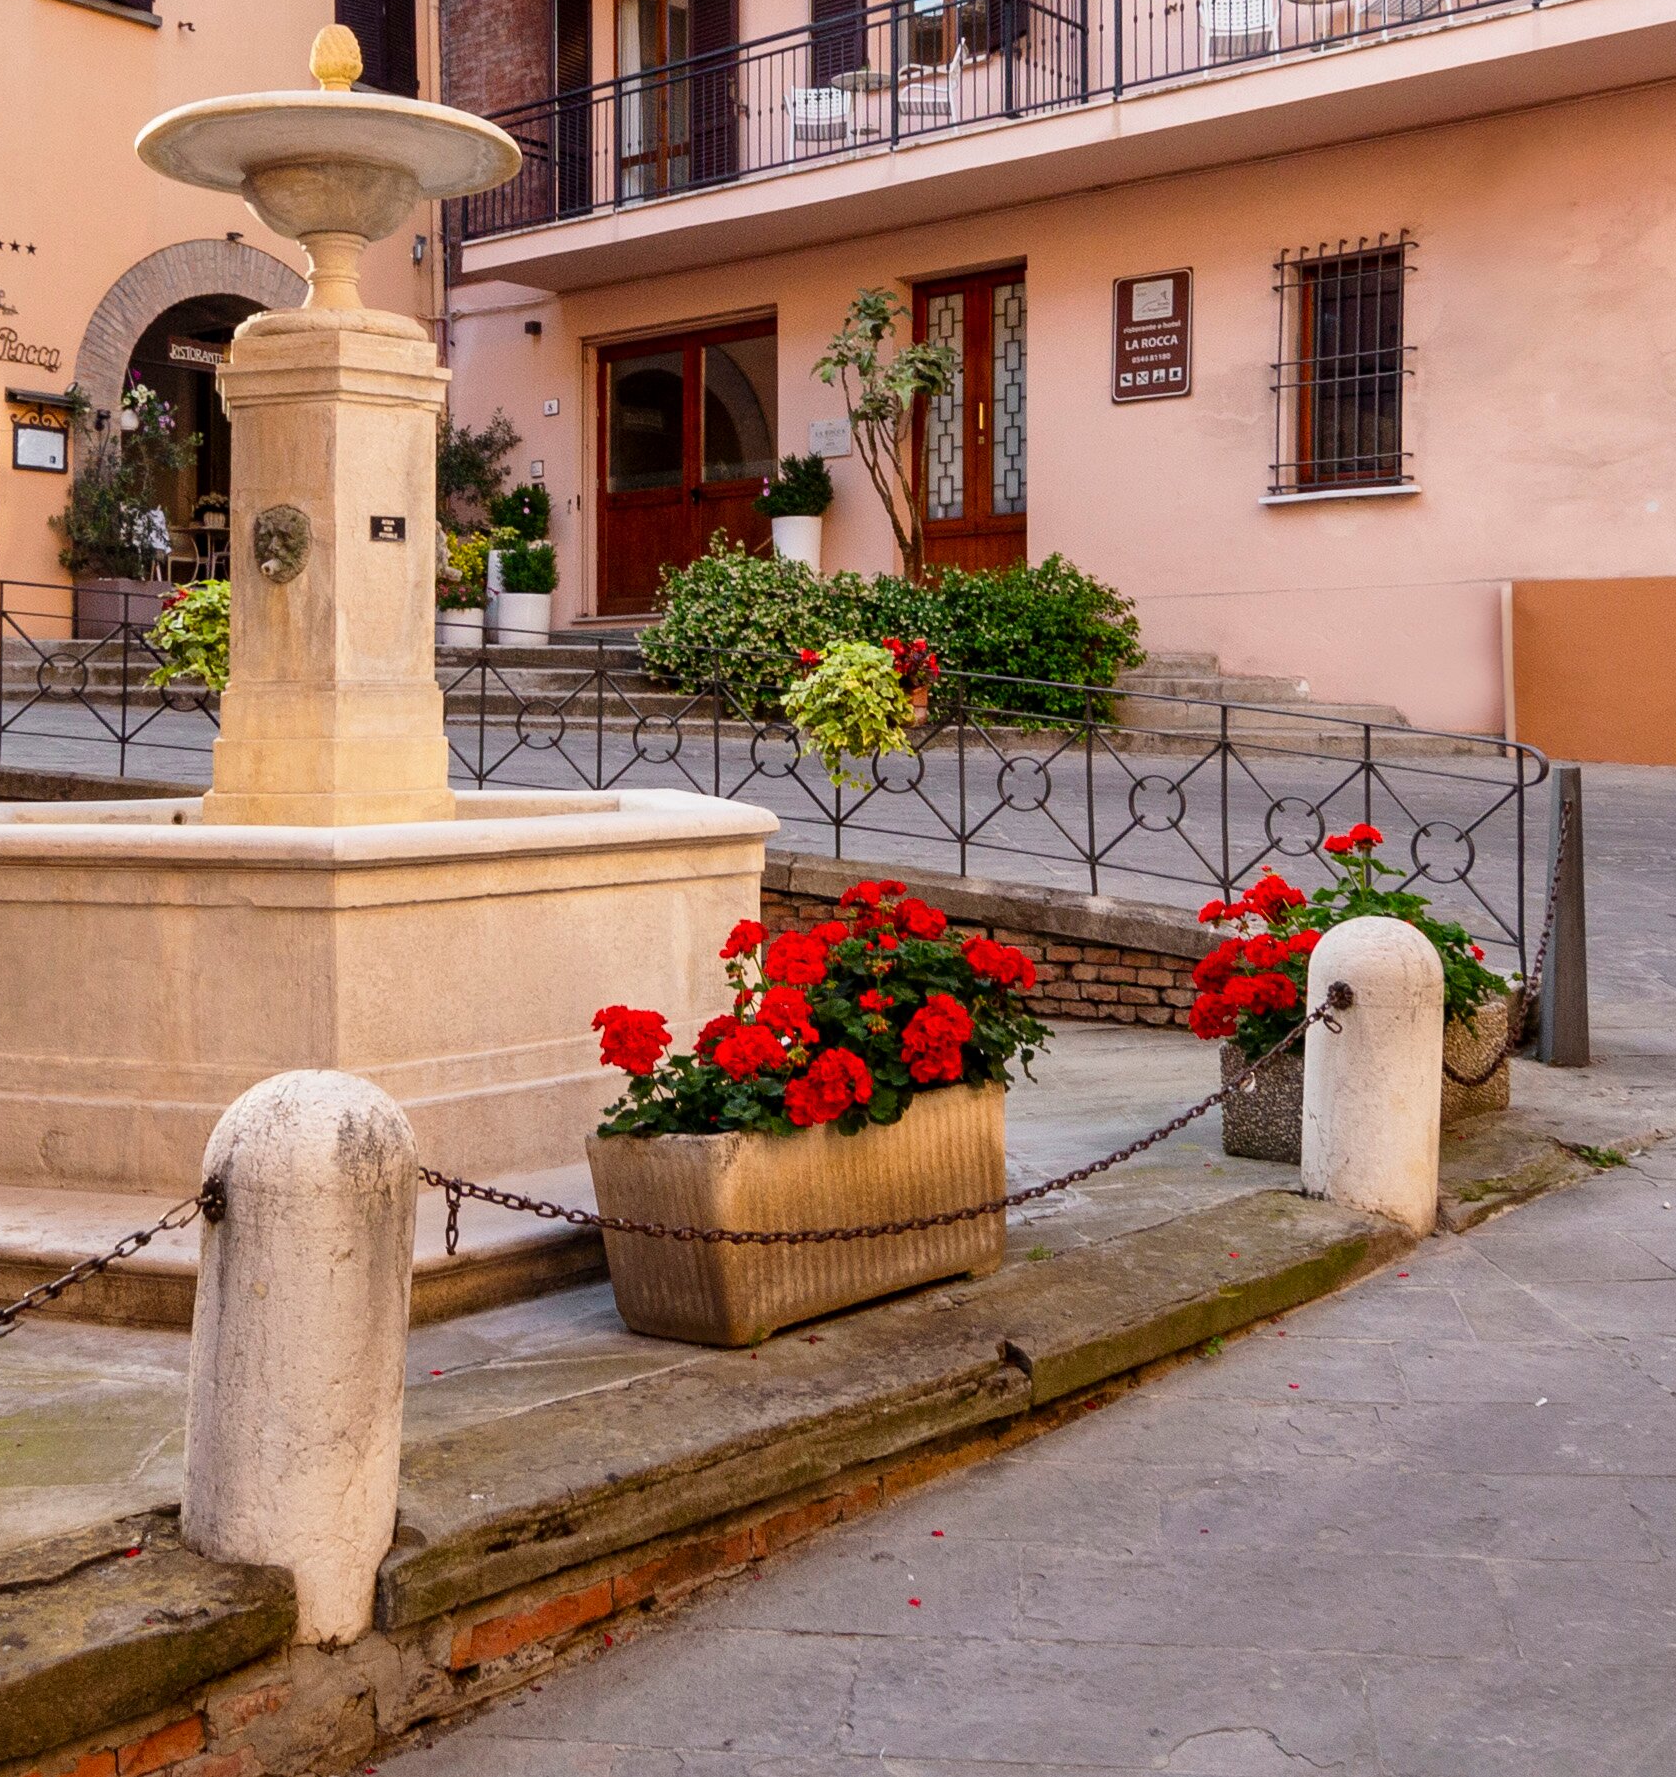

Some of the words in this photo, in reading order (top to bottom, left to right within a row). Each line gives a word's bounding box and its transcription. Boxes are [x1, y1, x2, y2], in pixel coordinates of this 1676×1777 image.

[1125, 339, 1139, 351] LA
[1141, 334, 1178, 349] ROCCA
[169, 343, 223, 363] RISTORANTE
